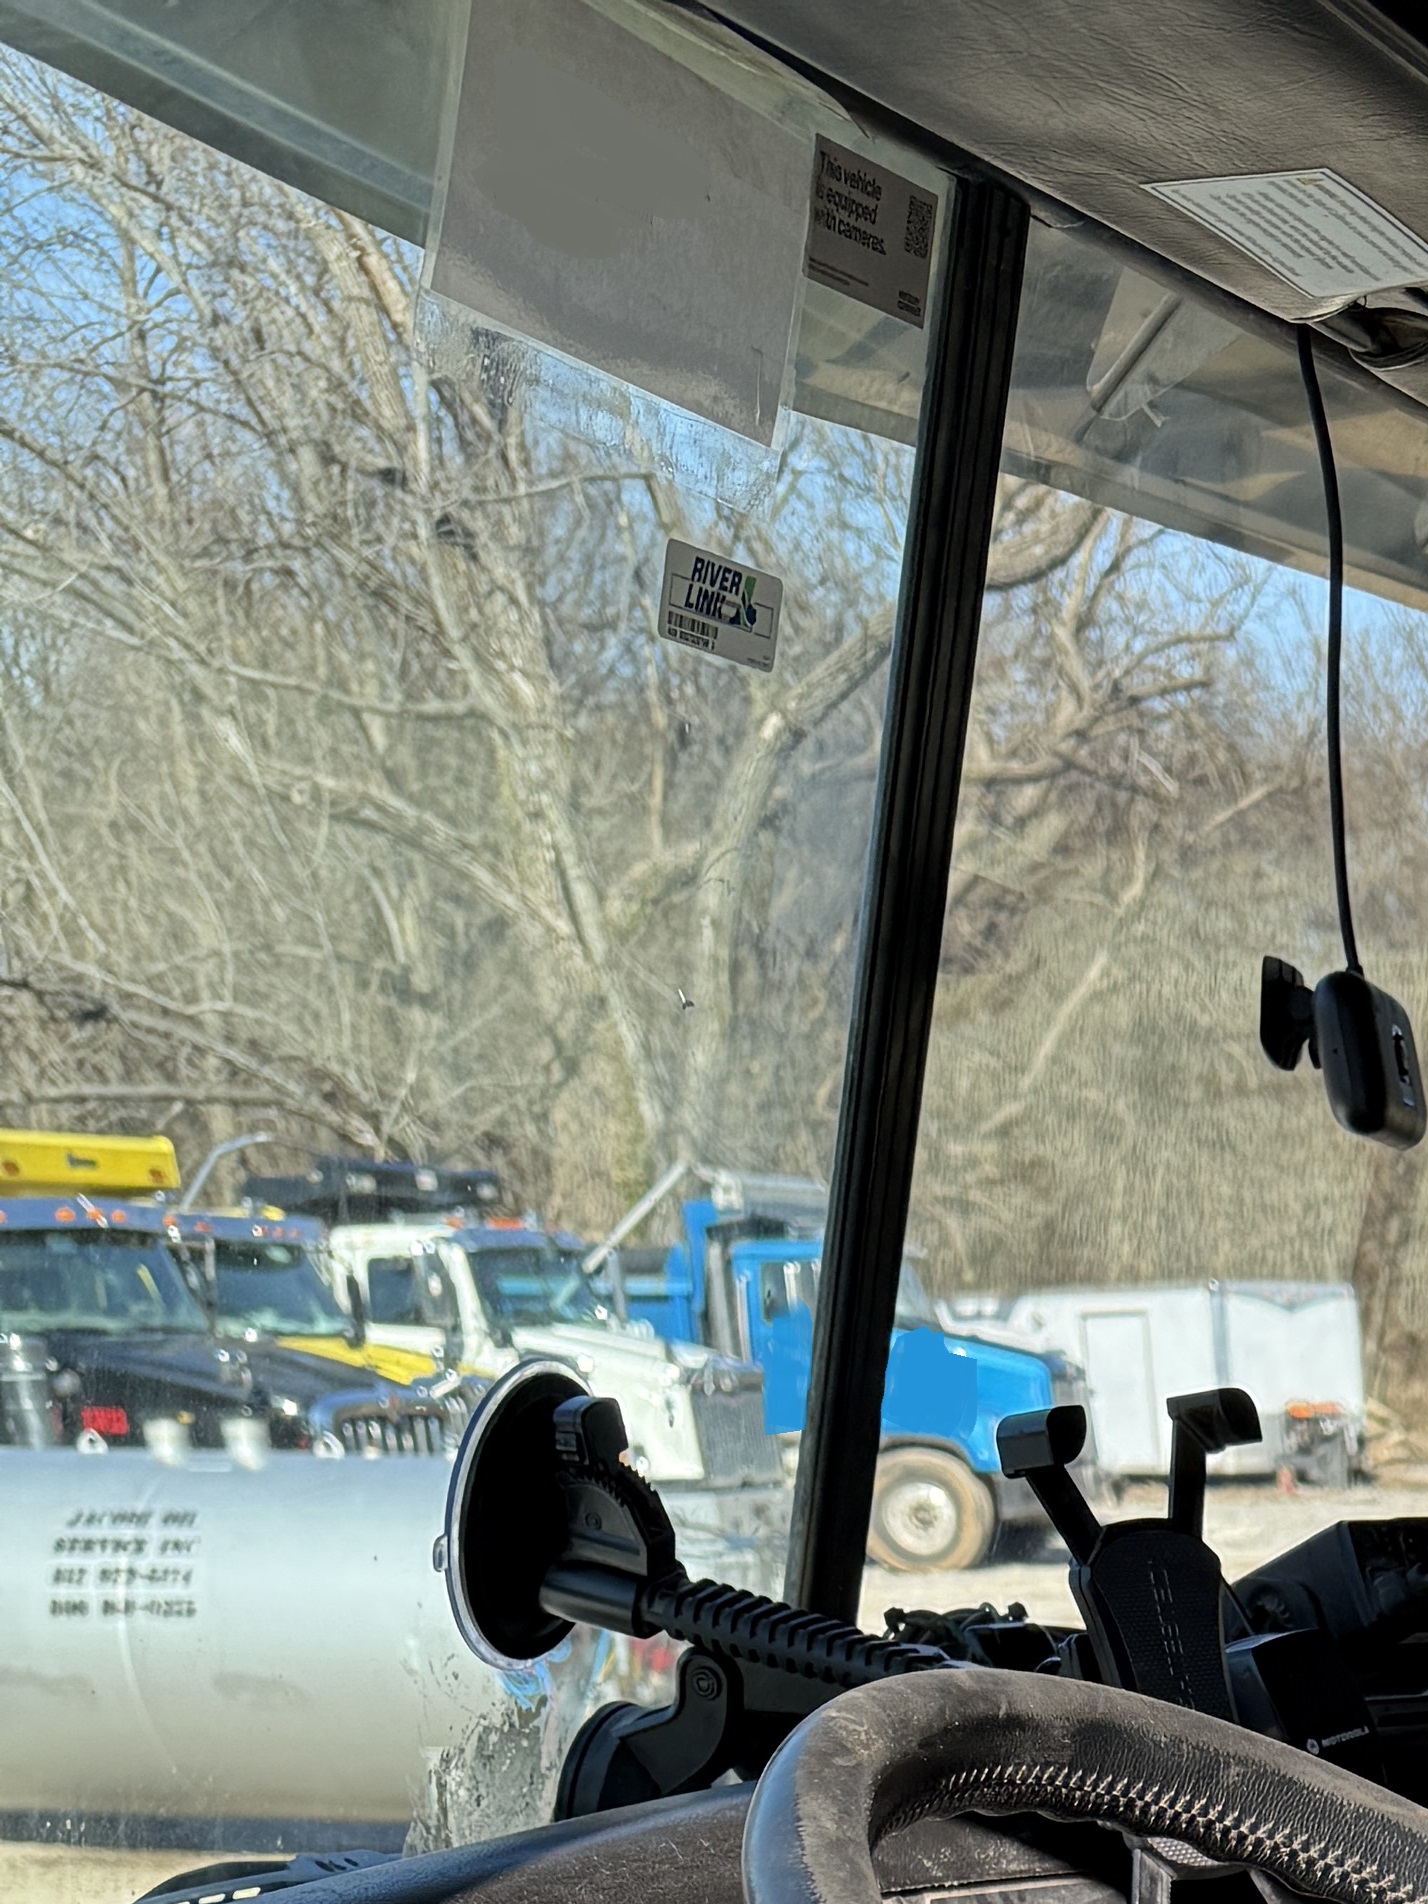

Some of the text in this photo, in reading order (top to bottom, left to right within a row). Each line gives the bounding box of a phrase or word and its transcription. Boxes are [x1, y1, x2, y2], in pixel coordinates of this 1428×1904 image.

[819, 151, 882, 201] This vehicle
[826, 187, 879, 225] equipped
[691, 556, 743, 596] RIVER
[684, 582, 727, 619] LINK
